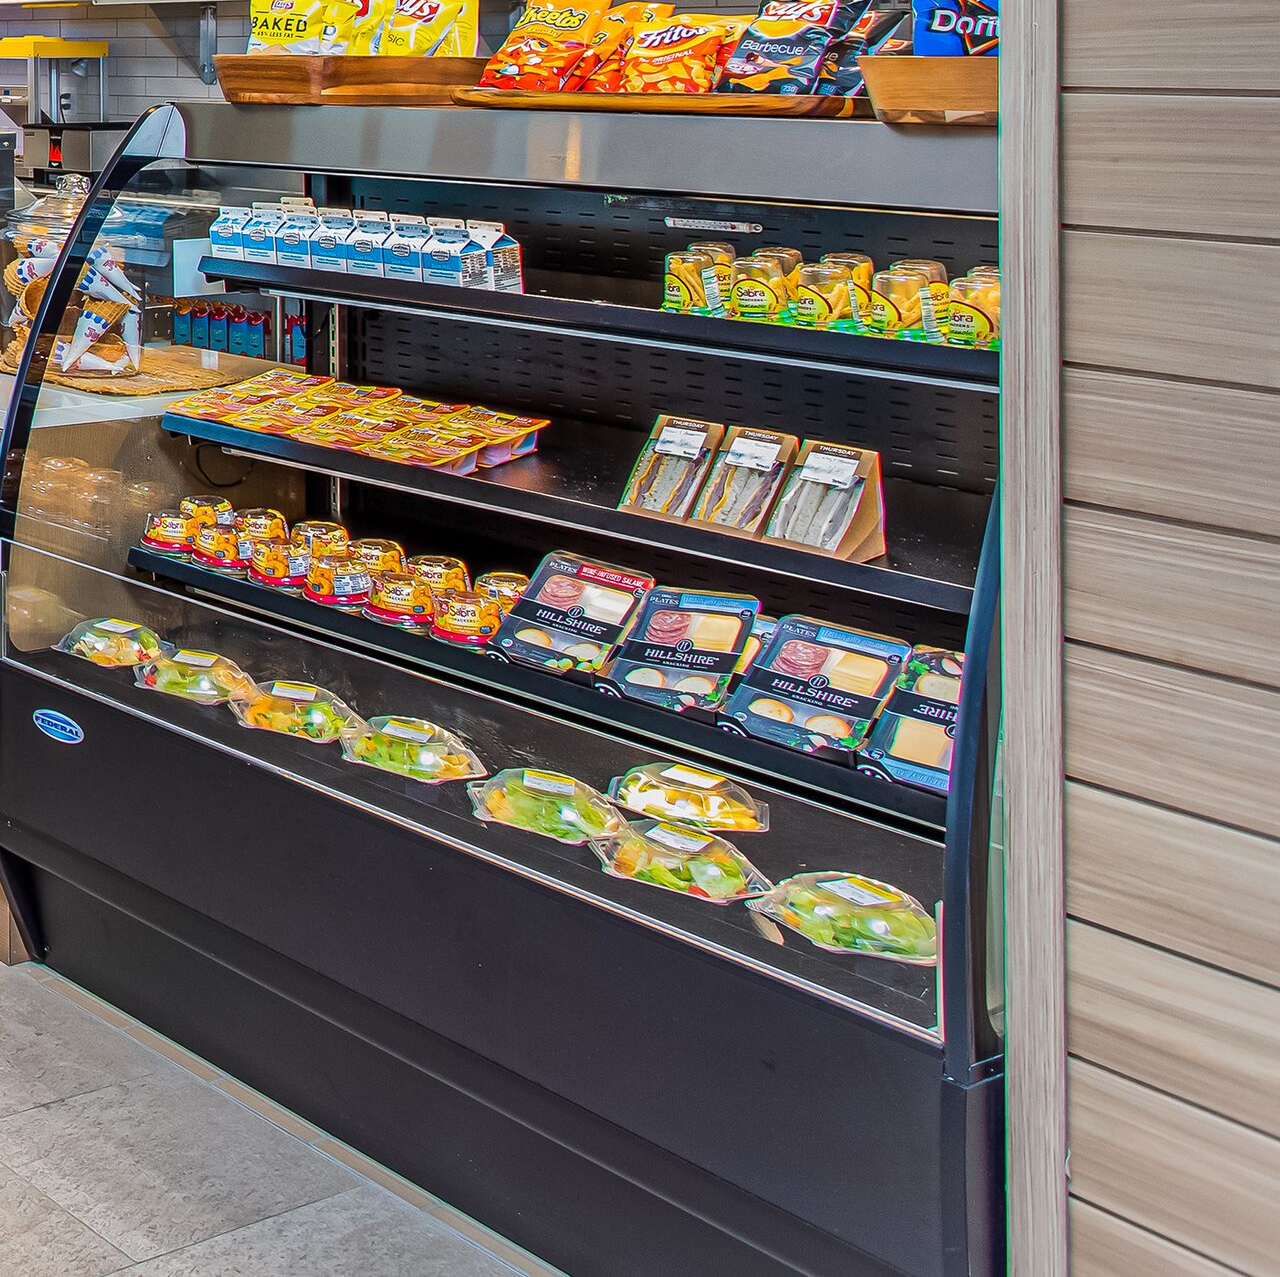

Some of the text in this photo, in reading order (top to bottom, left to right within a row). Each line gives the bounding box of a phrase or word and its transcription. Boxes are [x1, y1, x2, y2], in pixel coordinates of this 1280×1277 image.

[251, 16, 308, 32] BAKED
[637, 24, 709, 49] Fritos
[740, 39, 805, 56] Barbecue
[736, 285, 765, 298] Sabra
[672, 419, 705, 429] THURSDAY
[744, 430, 779, 441] THURSDAY
[819, 445, 856, 456] THURSDAY
[549, 561, 578, 574] PLATES
[649, 595, 679, 606] PLATES
[449, 605, 477, 617] Sabra
[536, 608, 604, 635] HILLSHIRE
[782, 623, 817, 638] PLATES
[644, 648, 715, 666] HILLSHIRE
[771, 678, 854, 708] HILLSHIRE
